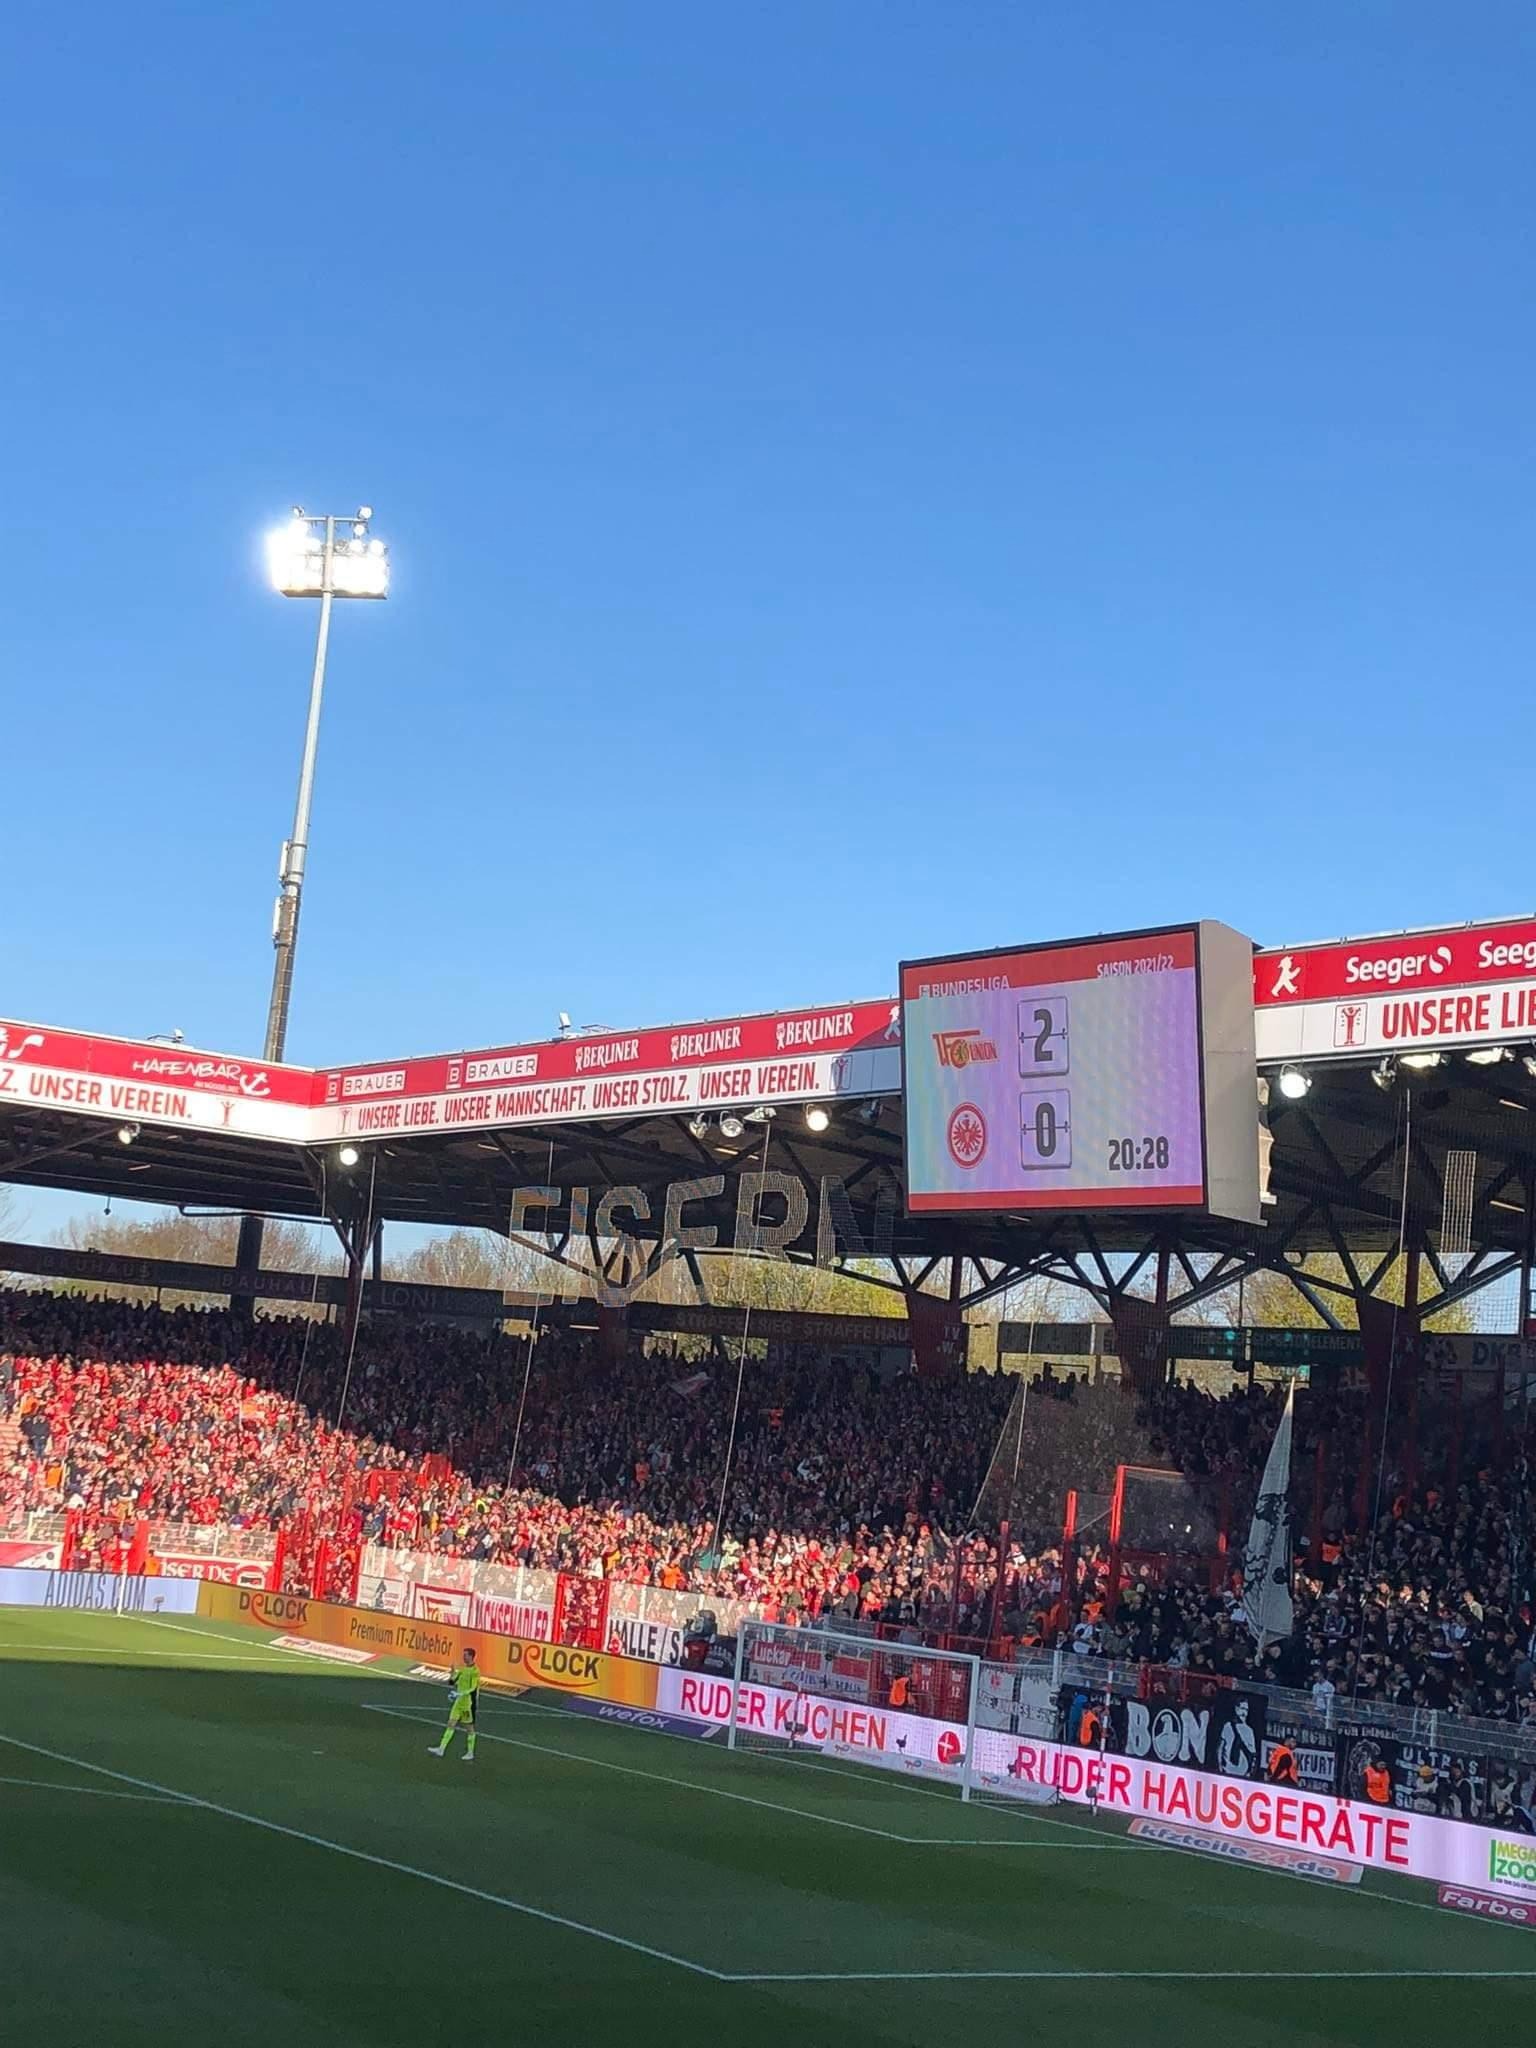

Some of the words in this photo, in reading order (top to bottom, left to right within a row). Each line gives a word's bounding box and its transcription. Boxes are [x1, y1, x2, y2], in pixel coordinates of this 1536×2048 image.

[1096, 960, 1132, 978] SAISON
[1133, 953, 1174, 977] 2021/22
[1346, 955, 1426, 984] Seeger
[1478, 941, 1536, 969] Seeg
[932, 975, 1010, 998] BUNDESLIGA
[784, 1013, 854, 1046] BERLINER
[1382, 994, 1490, 1039] UNSERE
[678, 1026, 742, 1057] BERLINER
[1034, 1008, 1053, 1062] 2
[467, 1057, 536, 1079] BRAUER
[580, 1039, 640, 1068] BERLINER
[133, 1058, 241, 1081] HAFENBAR
[344, 1074, 404, 1093] BRAUER
[30, 1072, 101, 1105] UNSER
[111, 1085, 192, 1119] VEREIN.
[358, 1105, 400, 1131] UNSERE
[404, 1101, 439, 1126] LIEBE.
[445, 1096, 491, 1123] UNSERE
[496, 1085, 585, 1119] MANNSCHAFT.
[592, 1080, 639, 1110] UNSER
[642, 1075, 690, 1105] STOLZ.
[700, 1068, 750, 1100] UNSER
[757, 1062, 819, 1094] VEREIN.
[1036, 1102, 1056, 1157] 0
[1108, 1136, 1169, 1171] 20:28
[351, 1616, 393, 1644] Premium
[396, 1627, 452, 1657] IT-Zubehör
[598, 1704, 670, 1730] wefox
[680, 1677, 766, 1728] RUDER
[773, 1692, 887, 1751] KÜCHEN
[1016, 1745, 1133, 1806] RUDER
[1143, 1767, 1411, 1866] HAUSGERÄTE
[1140, 1824, 1338, 1882] kfzteile24.de
[1497, 1840, 1536, 1862] MEGA
[1495, 1858, 1536, 1882] ZOO
[1441, 1889, 1529, 1921] Farbe
